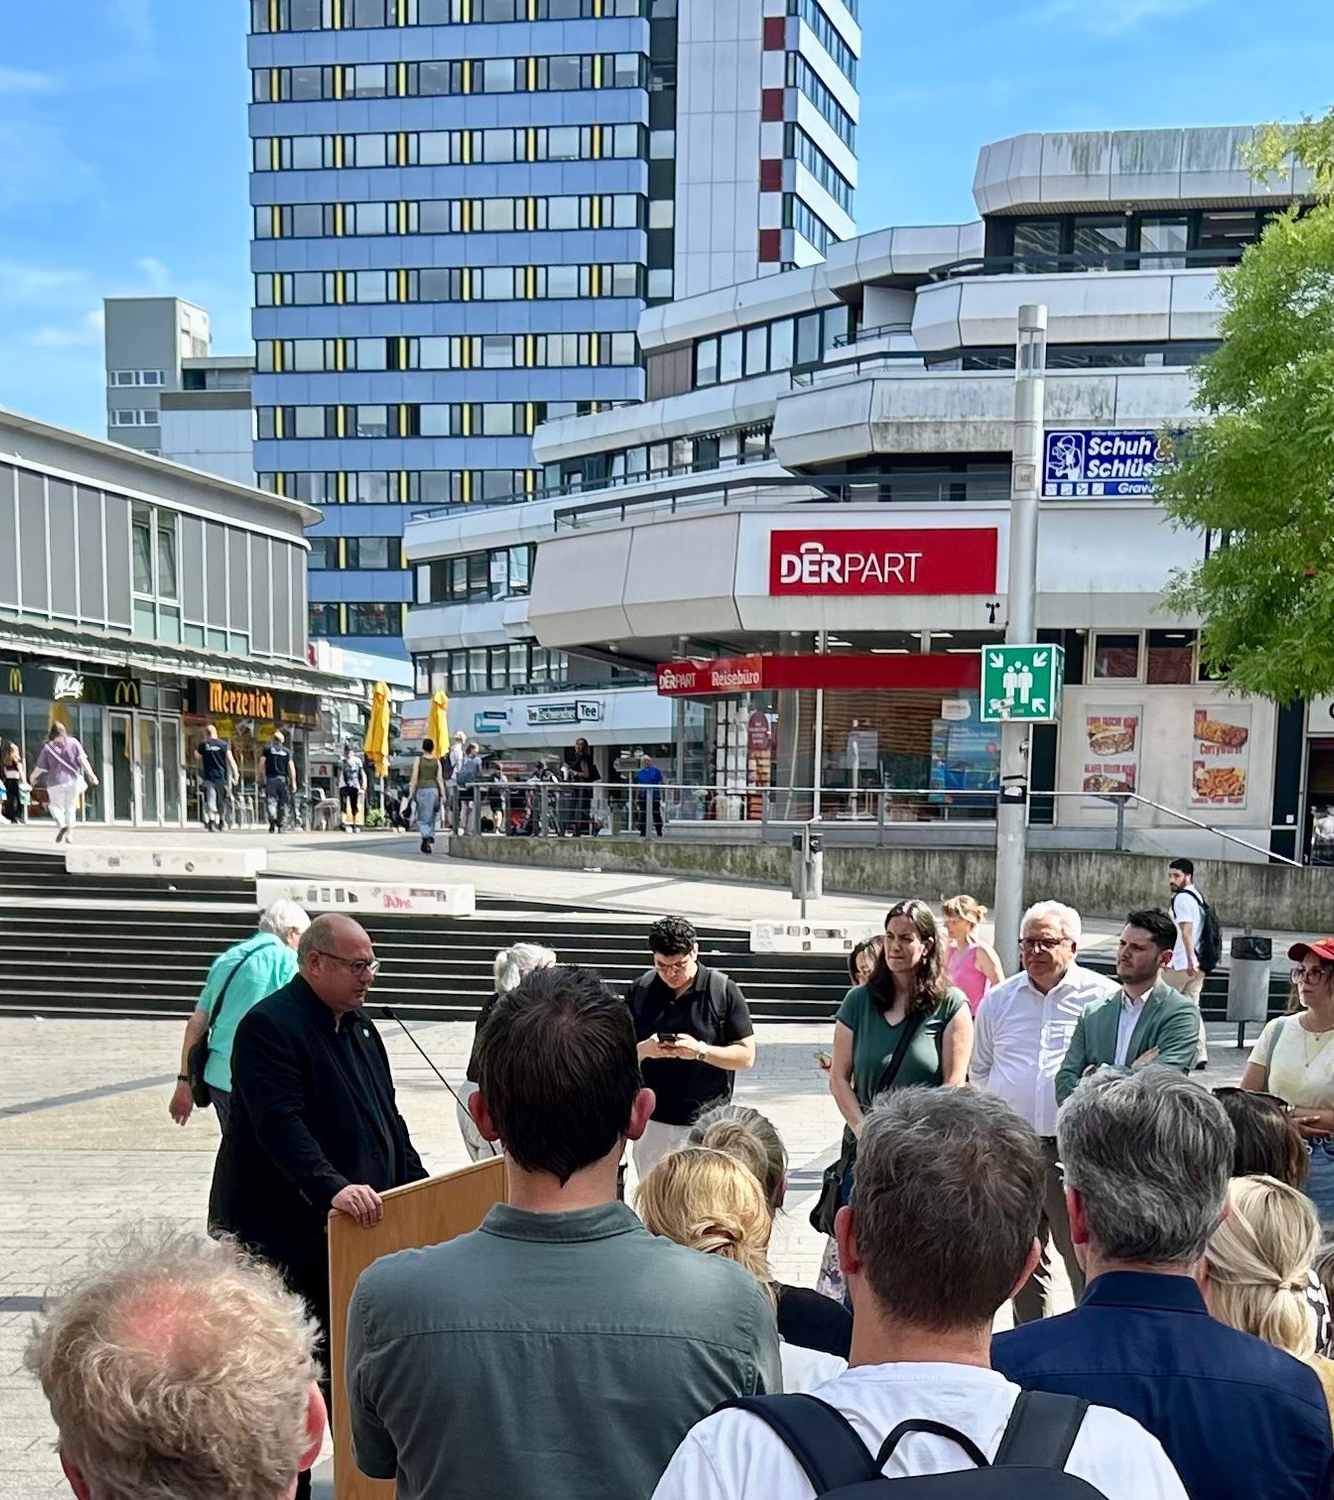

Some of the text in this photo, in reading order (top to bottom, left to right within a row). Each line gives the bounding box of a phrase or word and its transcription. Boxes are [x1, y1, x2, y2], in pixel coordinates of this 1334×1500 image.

[1088, 437, 1152, 456] Schuh
[780, 548, 923, 584] DERPART
[711, 668, 760, 687] Reisebüro
[209, 681, 274, 719] Merzenich
[580, 704, 597, 717] Tee
